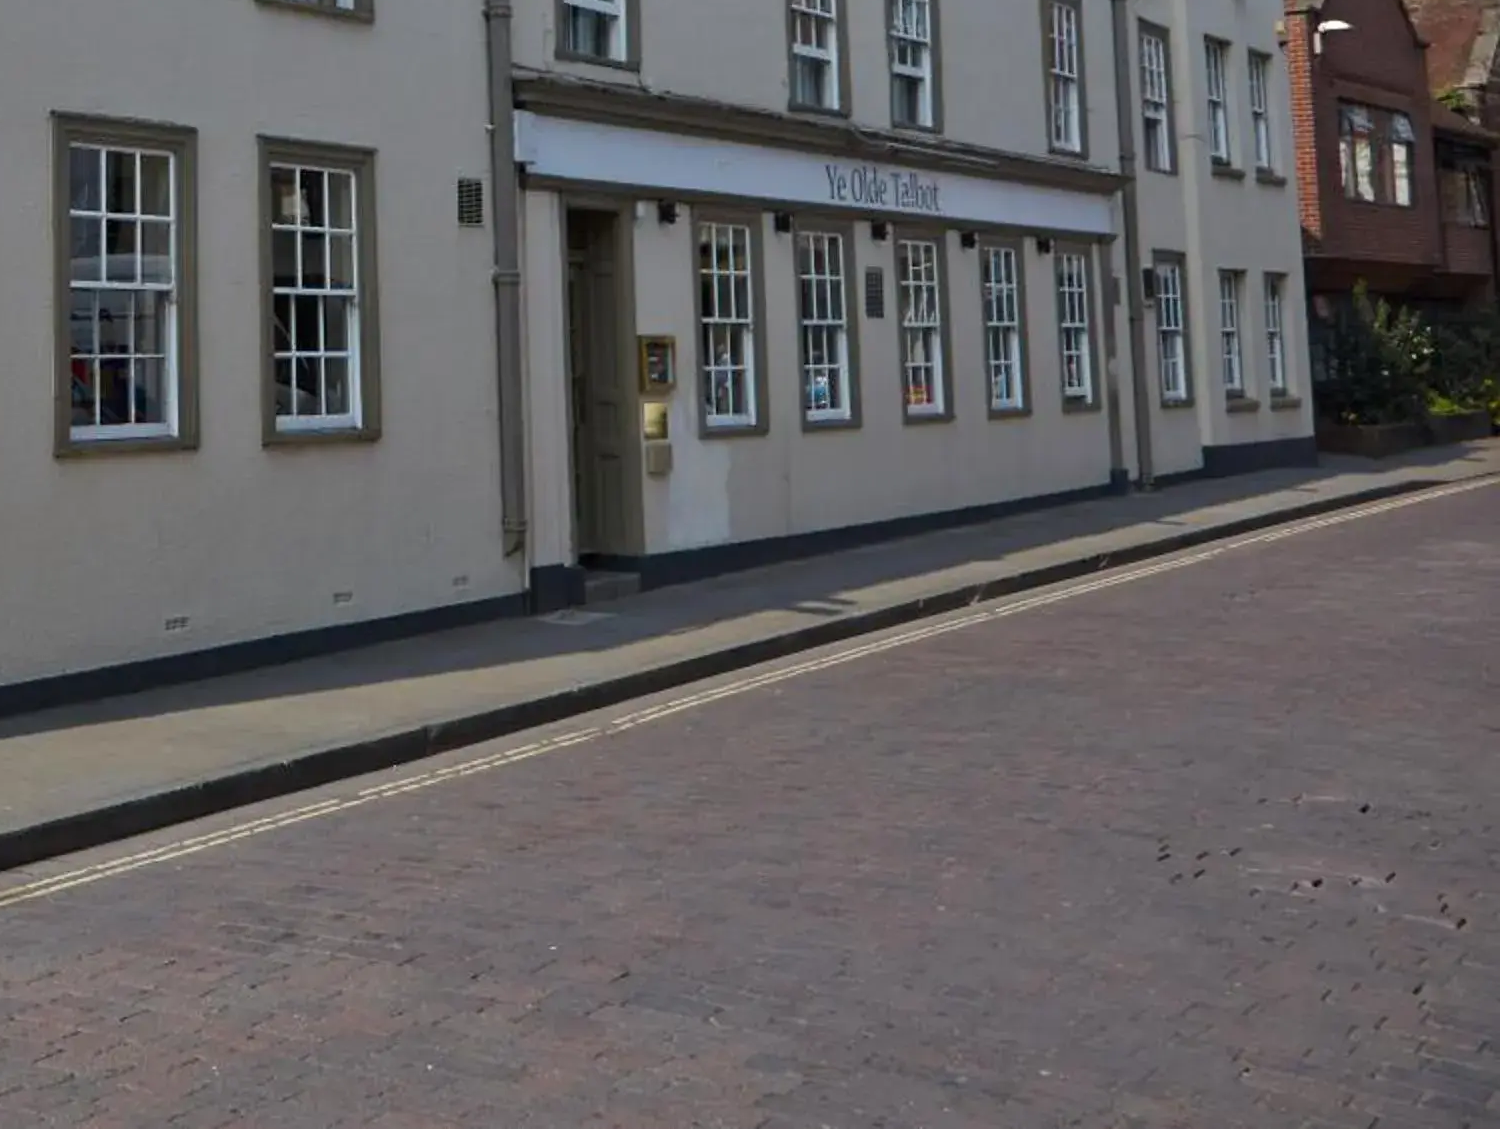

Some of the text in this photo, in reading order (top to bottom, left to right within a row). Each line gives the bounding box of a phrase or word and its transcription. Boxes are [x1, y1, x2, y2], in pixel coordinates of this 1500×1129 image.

[825, 164, 940, 211] Ye Olde Talbot
